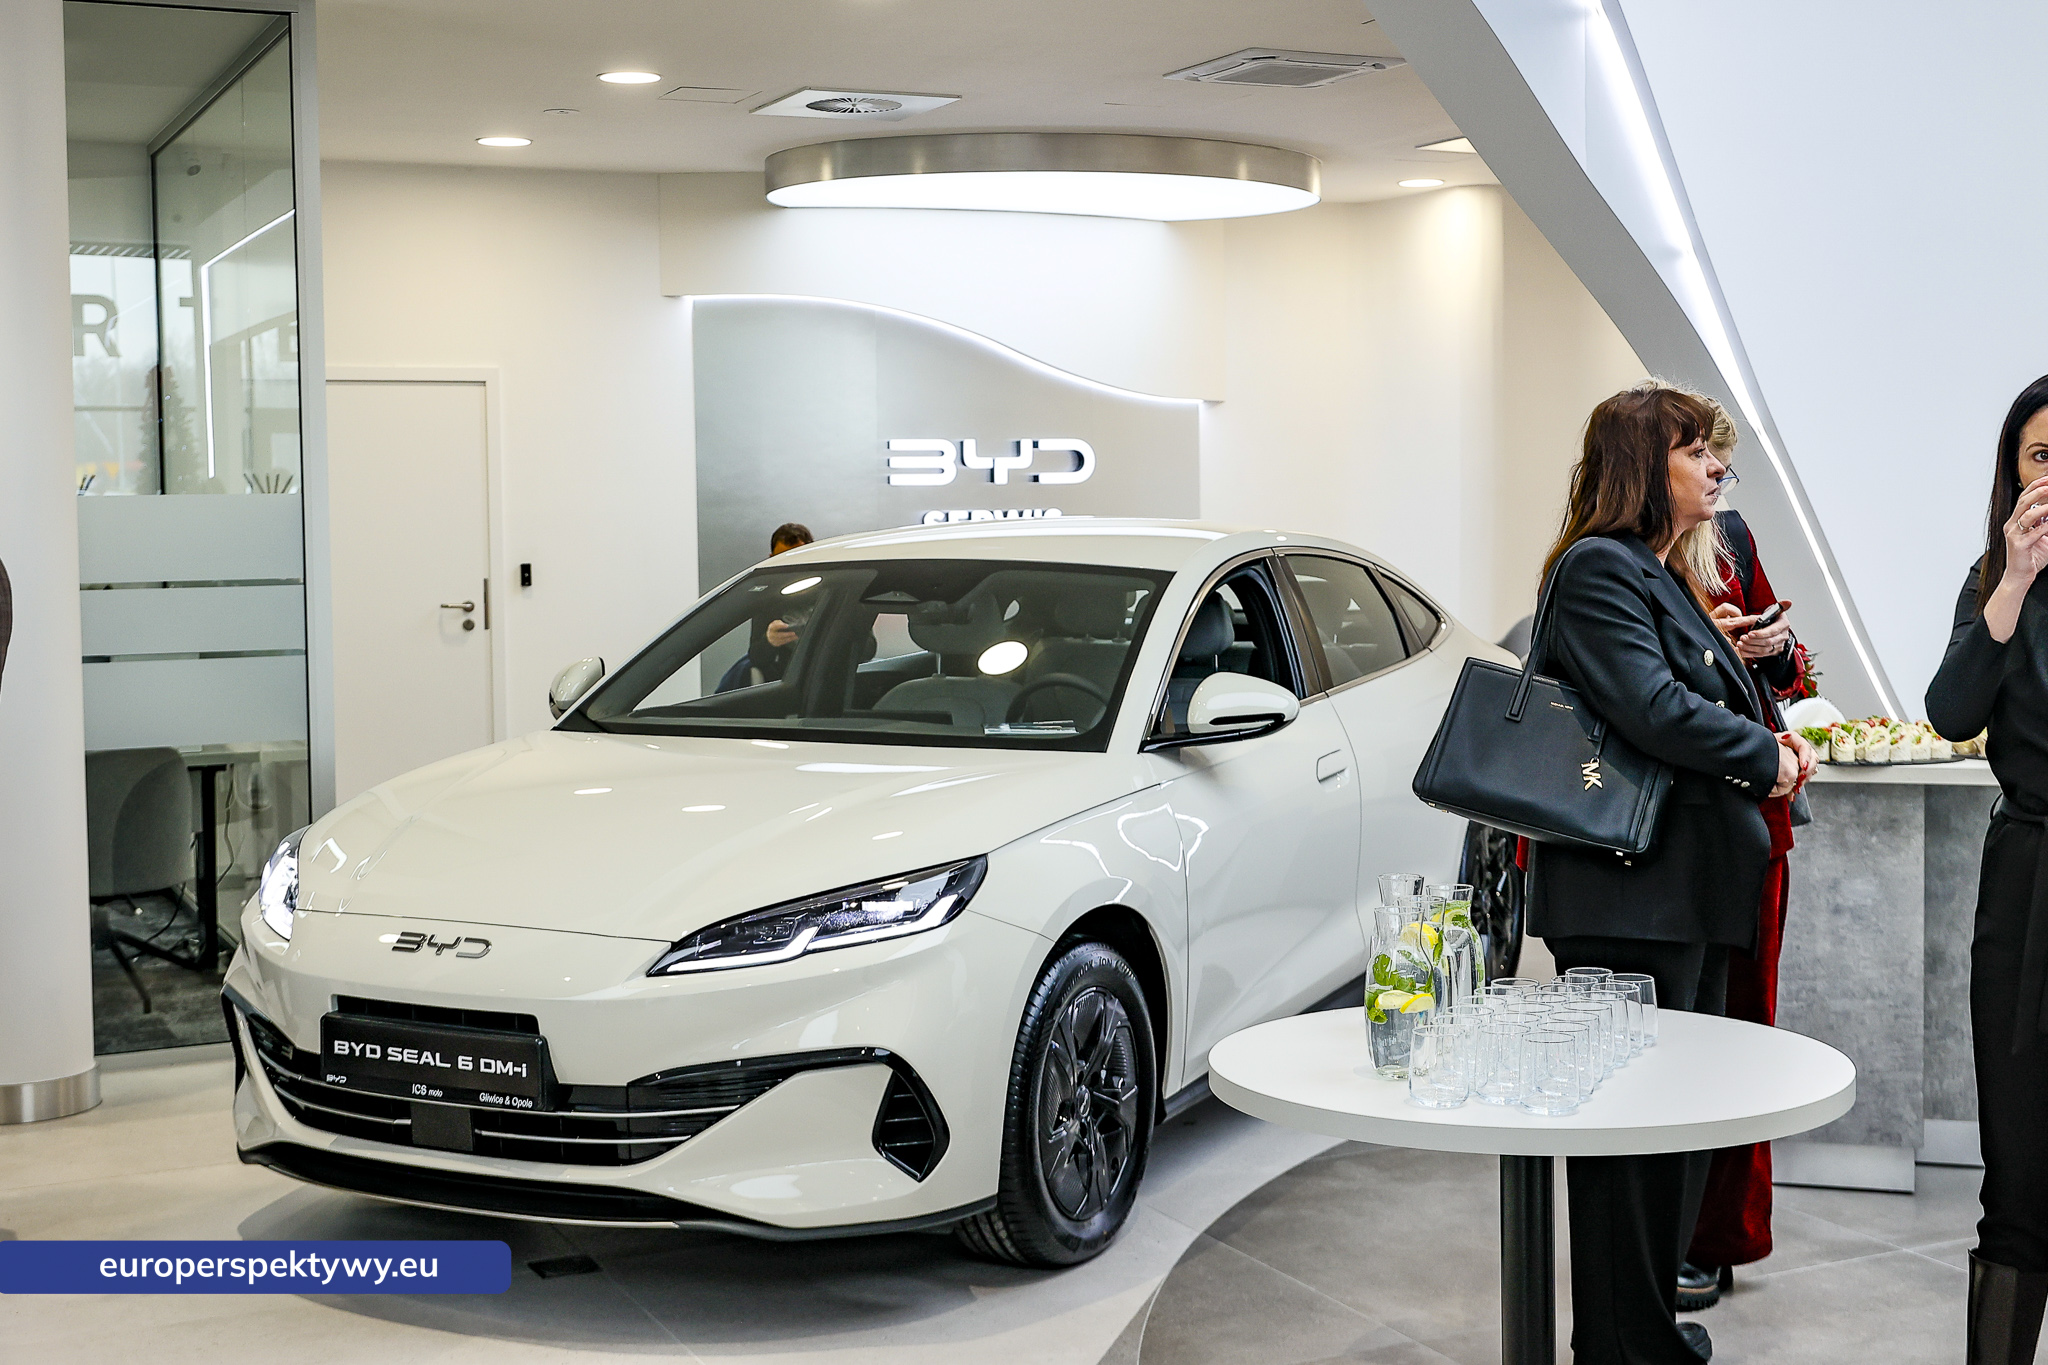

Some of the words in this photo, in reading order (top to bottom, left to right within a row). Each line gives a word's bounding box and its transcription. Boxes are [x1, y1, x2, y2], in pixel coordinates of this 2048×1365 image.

[886, 438, 1096, 486] BYD
[391, 931, 492, 959] BYD
[333, 1039, 381, 1060] BYD
[387, 1047, 452, 1068] SEAL
[457, 1055, 474, 1071] 6
[480, 1057, 527, 1078] DM-i
[326, 1073, 347, 1084] BYD
[479, 1092, 504, 1105] Gliwice
[511, 1097, 533, 1109] Opole
